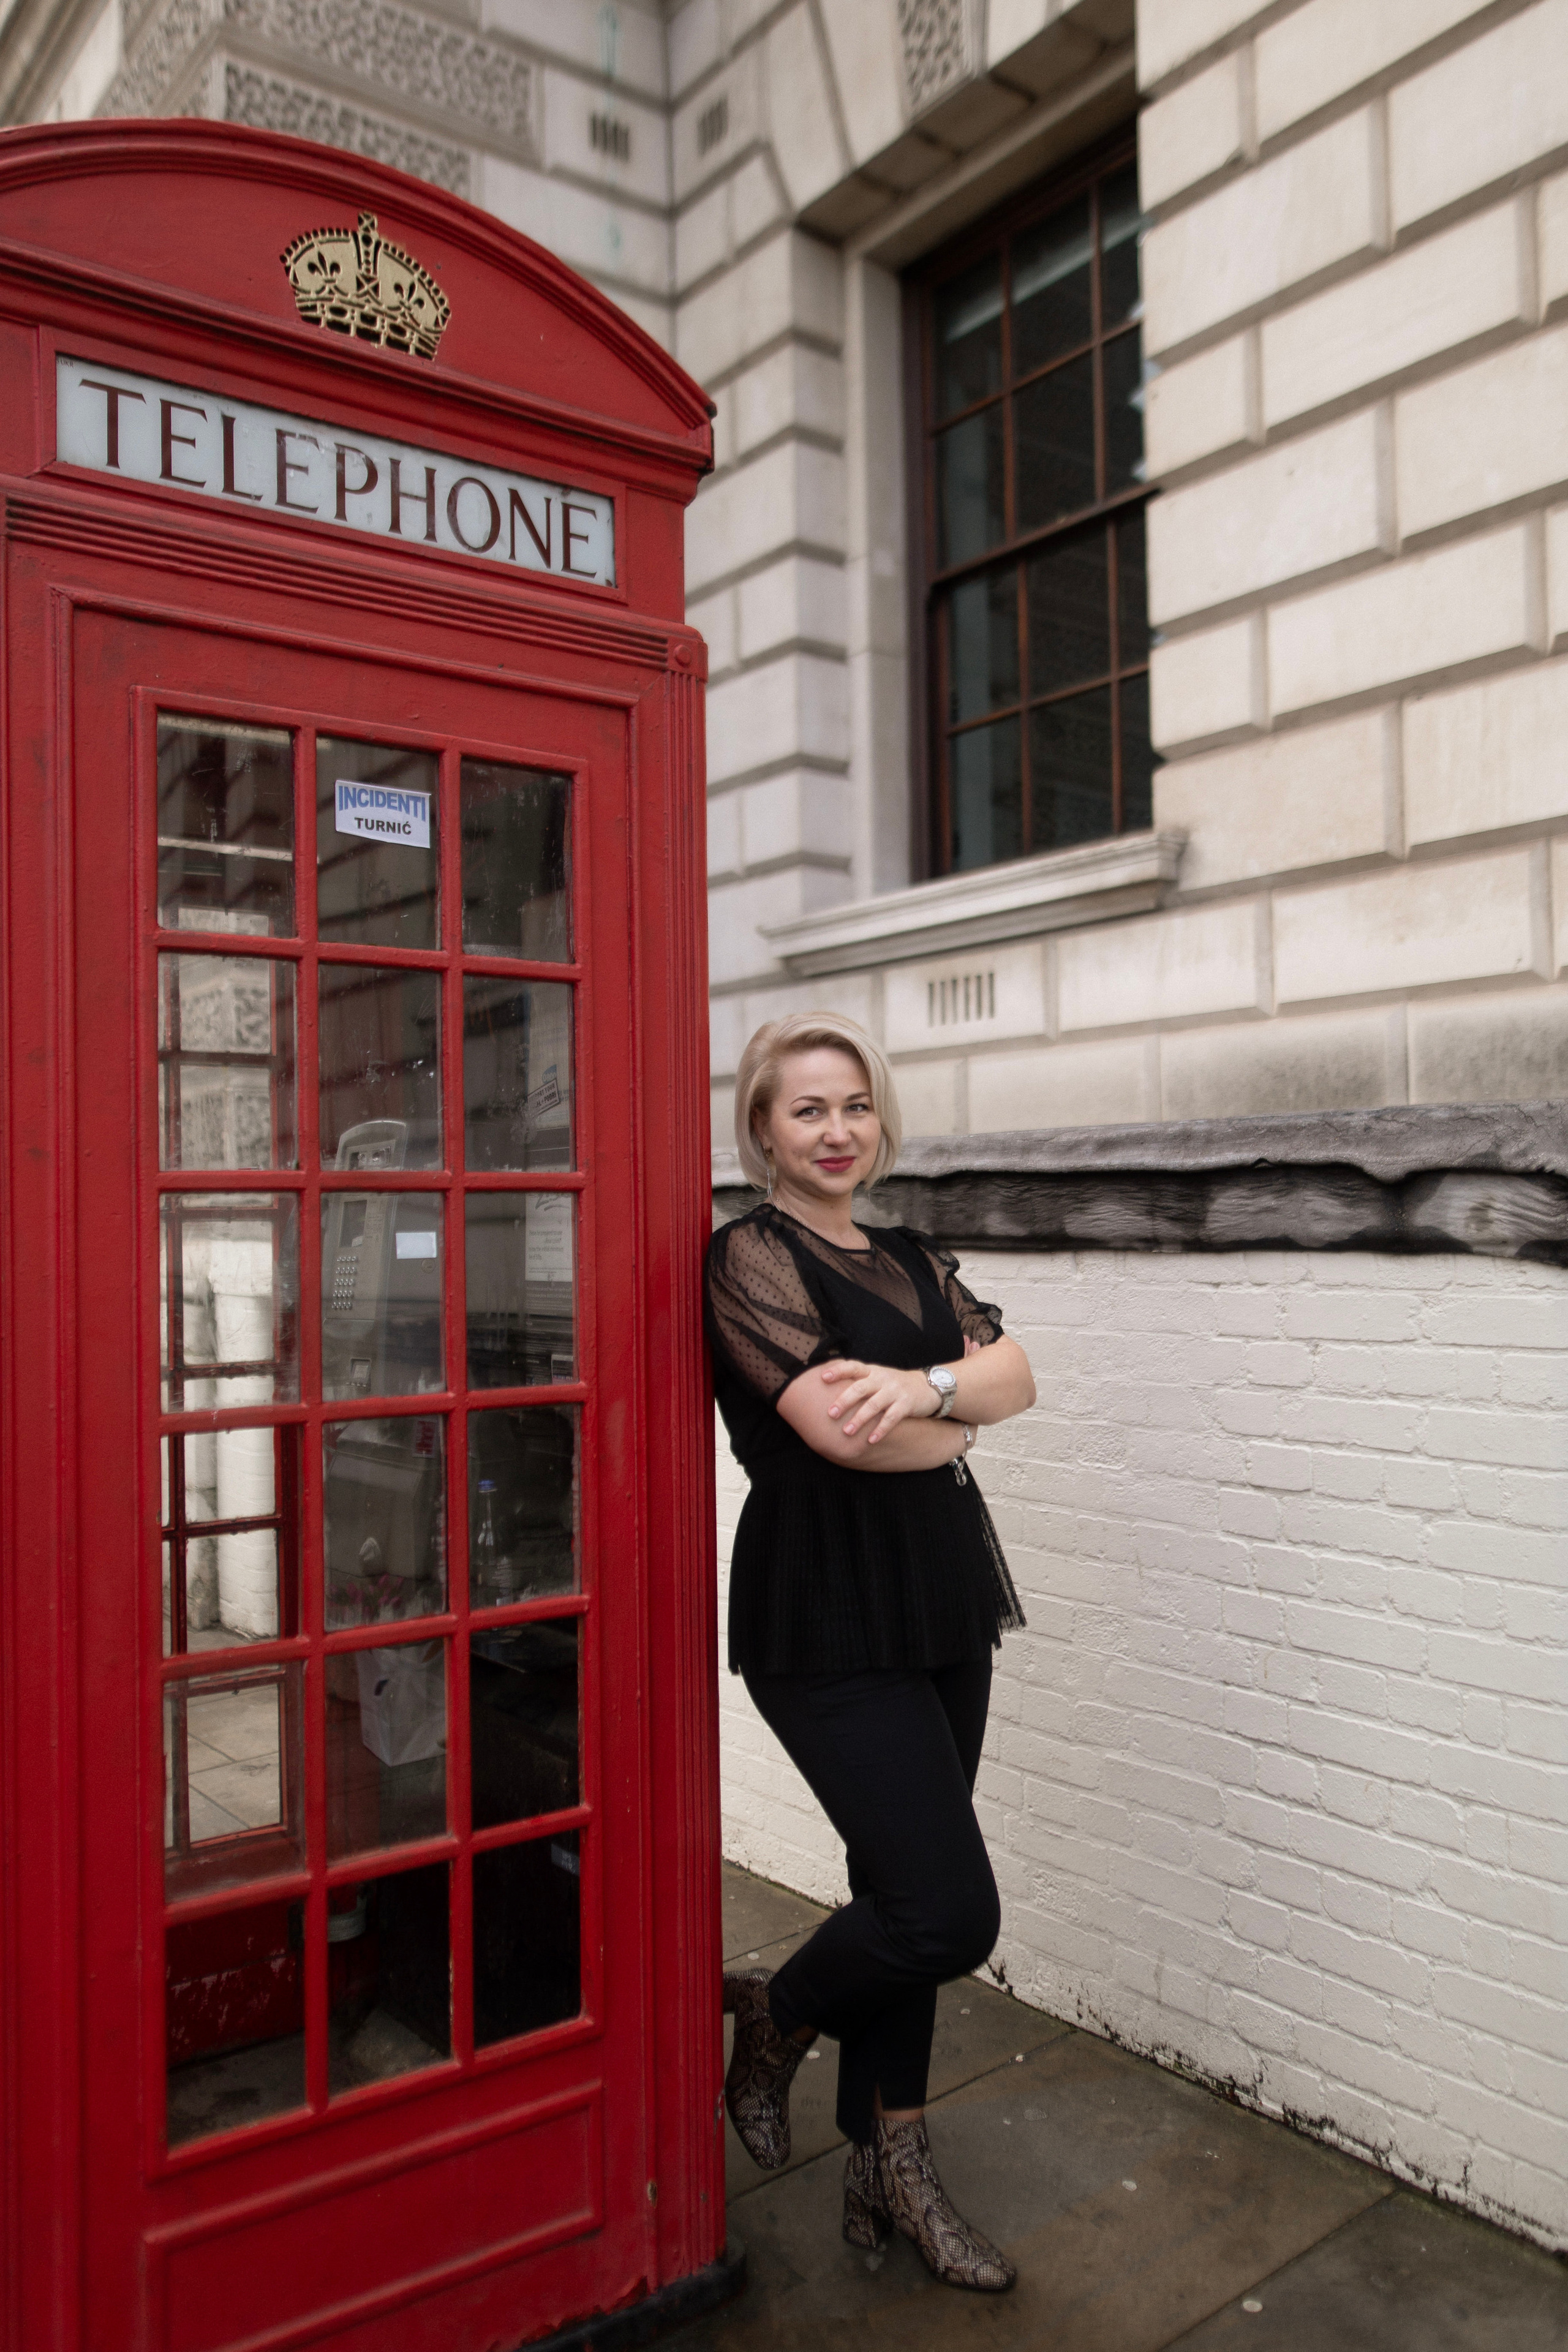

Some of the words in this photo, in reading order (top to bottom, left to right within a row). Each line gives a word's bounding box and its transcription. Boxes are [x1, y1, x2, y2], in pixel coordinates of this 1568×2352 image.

[78, 379, 598, 578] TELEPHONE
[338, 785, 426, 822] INCIDENTI
[354, 816, 412, 835] TURNIĆ
